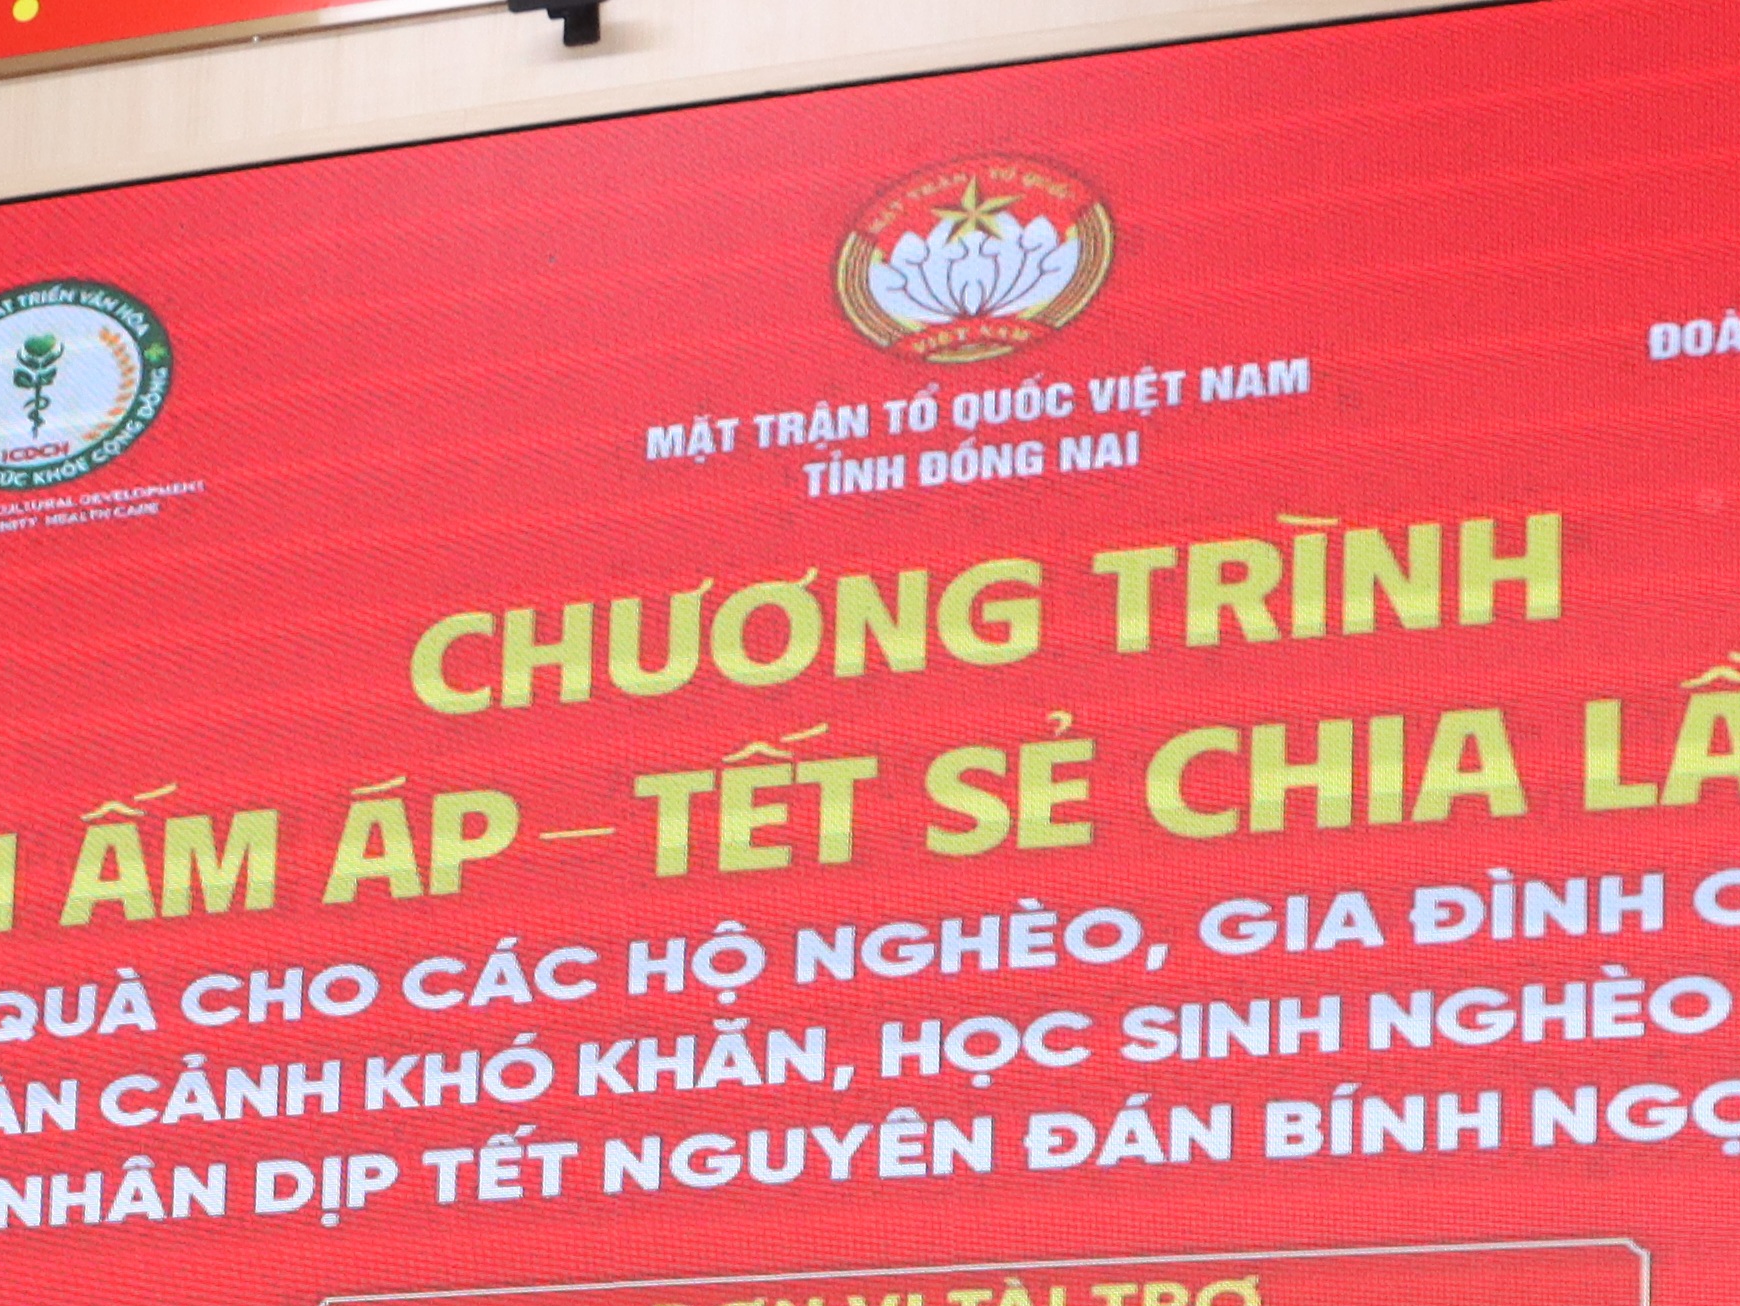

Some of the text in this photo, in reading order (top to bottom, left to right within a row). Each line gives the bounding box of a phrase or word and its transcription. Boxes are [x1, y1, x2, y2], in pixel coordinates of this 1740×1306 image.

[646, 358, 1310, 463] MẶT TRẬN TỔ QUỐC VIỆT NAM
[803, 431, 1139, 497] TỈNH ĐỒNG NAI
[410, 512, 1562, 715] CHƯƠNG TRÌNH
[59, 783, 279, 927] ẤM
[322, 775, 520, 904] ÁP
[634, 723, 878, 877] TẾT
[925, 710, 1094, 856] SẺ
[1145, 708, 1527, 838] CHIA
[180, 963, 379, 1027] CHO
[402, 936, 598, 1010] CÁC
[628, 920, 766, 1005] HỘ
[795, 897, 1168, 984] NGHÈO,
[1199, 891, 1385, 955] GIA
[1408, 867, 1664, 945] ĐÌNH
[99, 1053, 341, 1127] CẢNH
[365, 1032, 554, 1111] KHÓ
[578, 1017, 855, 1097] KHĂN,
[880, 1010, 1092, 1088] HỌC
[1121, 995, 1341, 1062] SINH
[1369, 964, 1733, 1050] NGHÈO
[254, 1154, 399, 1227] DỊP
[421, 1124, 579, 1204] TẾT
[603, 1107, 993, 1194] NGUYÊN
[1023, 1093, 1232, 1170] ĐÁN
[1265, 1083, 1501, 1159] BÍNH
